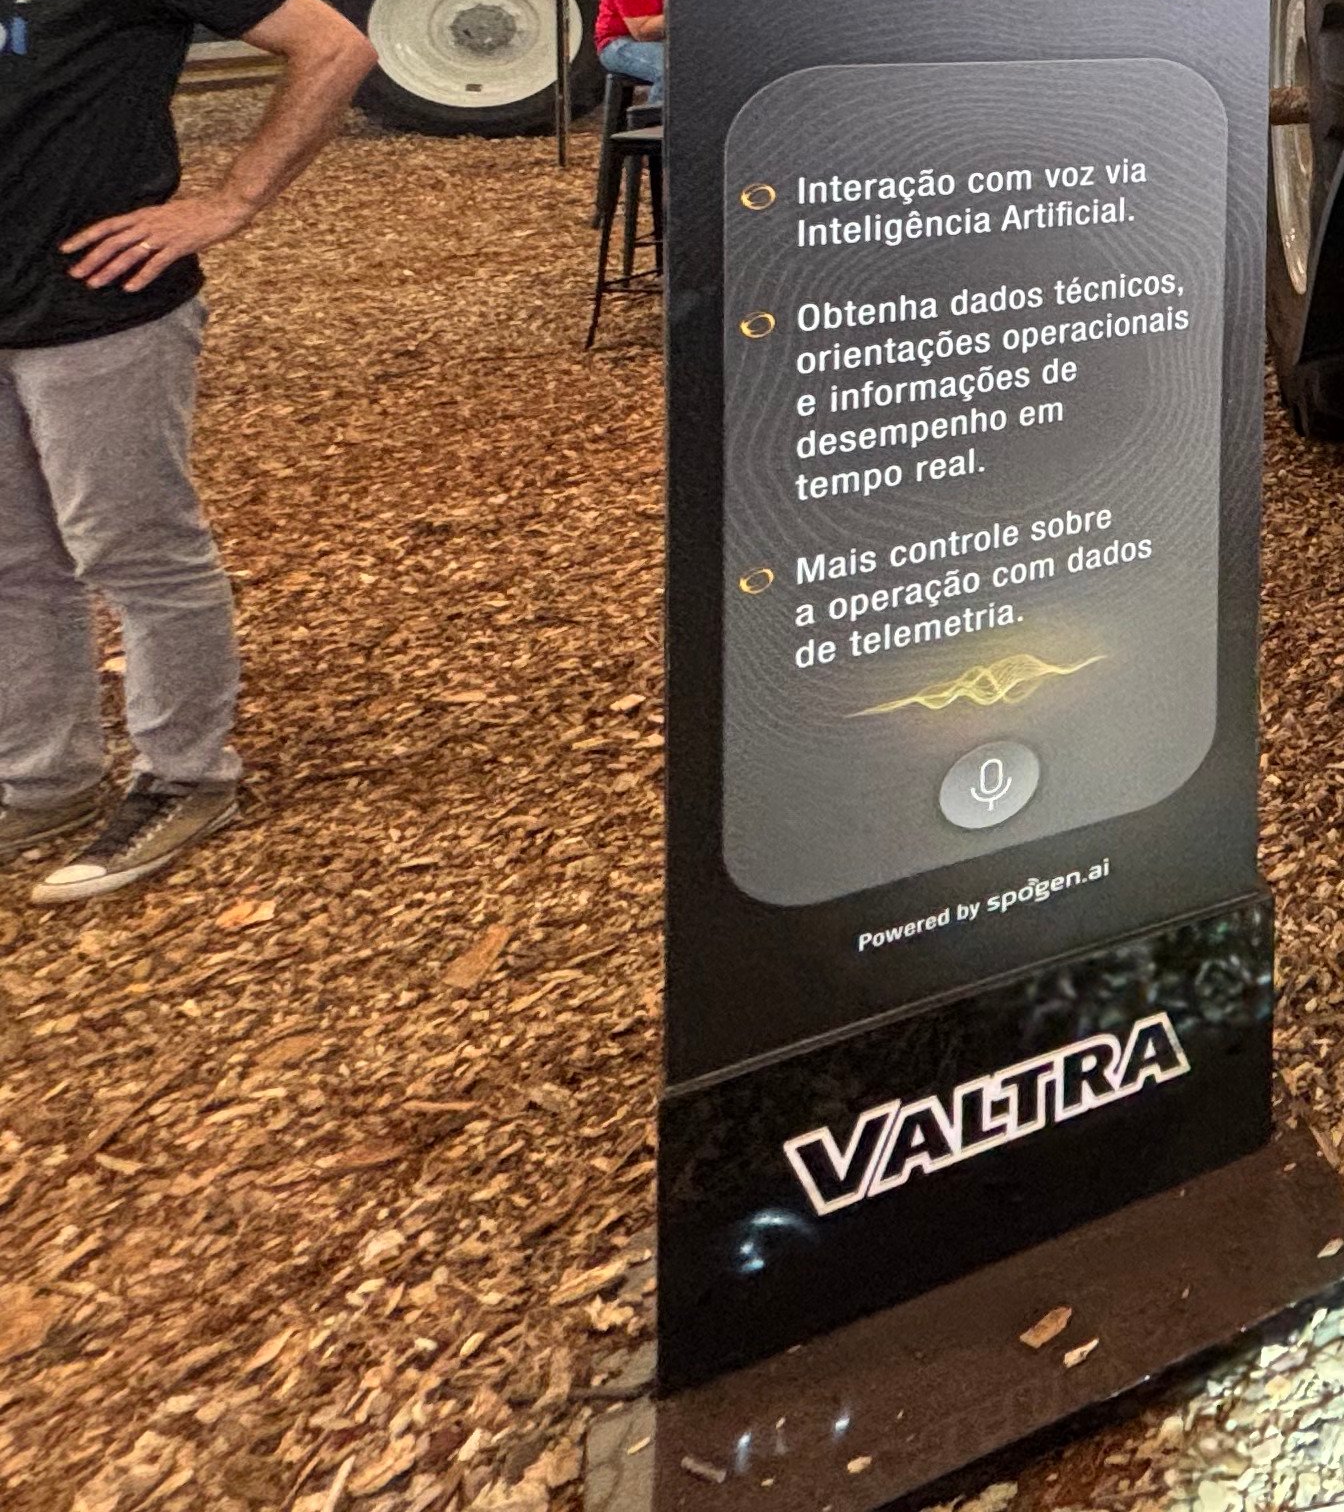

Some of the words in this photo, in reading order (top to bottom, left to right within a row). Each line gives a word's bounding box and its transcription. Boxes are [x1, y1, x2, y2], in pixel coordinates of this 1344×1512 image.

[798, 168, 956, 206] Interação
[967, 169, 1032, 194] com
[1044, 165, 1095, 188] voz
[1105, 157, 1147, 184] via
[797, 207, 992, 247] Inteligência
[1000, 196, 1135, 232] Artificial.
[797, 294, 939, 332] Obtenha
[950, 284, 1044, 316] dados
[1053, 273, 1184, 305] técnicos,
[796, 329, 994, 375] orientações
[1002, 305, 1189, 354] operacionais
[796, 394, 816, 417] e
[830, 365, 1031, 412] informações
[1041, 357, 1078, 385] de
[796, 408, 1006, 460] desempenho
[1019, 401, 1063, 427] em
[794, 464, 903, 501] tempo
[916, 447, 986, 482] real.
[796, 547, 877, 585] Mais
[889, 522, 1019, 568] controle
[1030, 508, 1112, 542] sobre
[795, 603, 816, 627] a
[828, 574, 980, 624] operação
[992, 557, 1055, 588] com
[1067, 538, 1153, 573] dados
[795, 638, 837, 669] de
[850, 600, 1025, 657] telemetria.
[857, 908, 951, 953] Powered
[956, 899, 981, 925] by
[986, 858, 1111, 914] spogen.ai
[784, 1010, 1191, 1218] VALTRA
